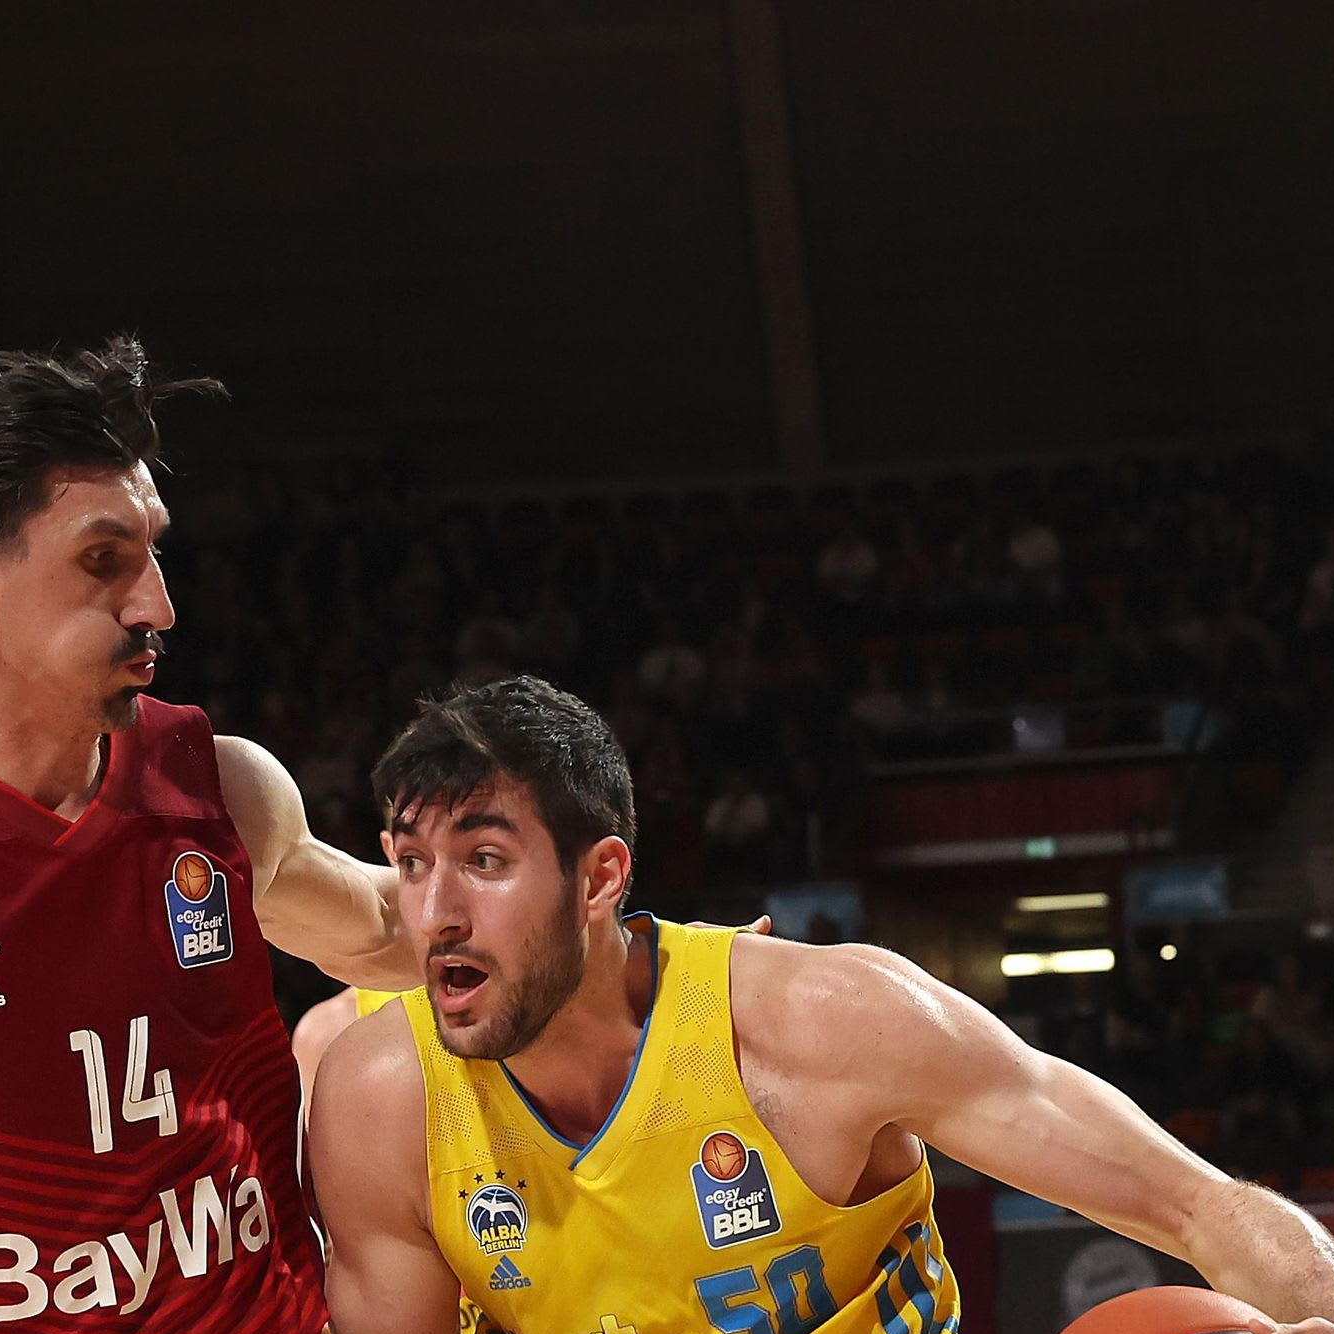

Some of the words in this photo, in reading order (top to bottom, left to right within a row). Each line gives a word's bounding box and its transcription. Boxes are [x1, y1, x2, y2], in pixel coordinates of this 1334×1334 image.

[183, 928, 225, 959] BBL
[70, 1015, 178, 1154] 14
[481, 1224, 522, 1245] ALBA
[713, 1204, 770, 1240] BBL
[486, 1239, 520, 1252] BERLIN
[489, 1277, 532, 1290] adidas
